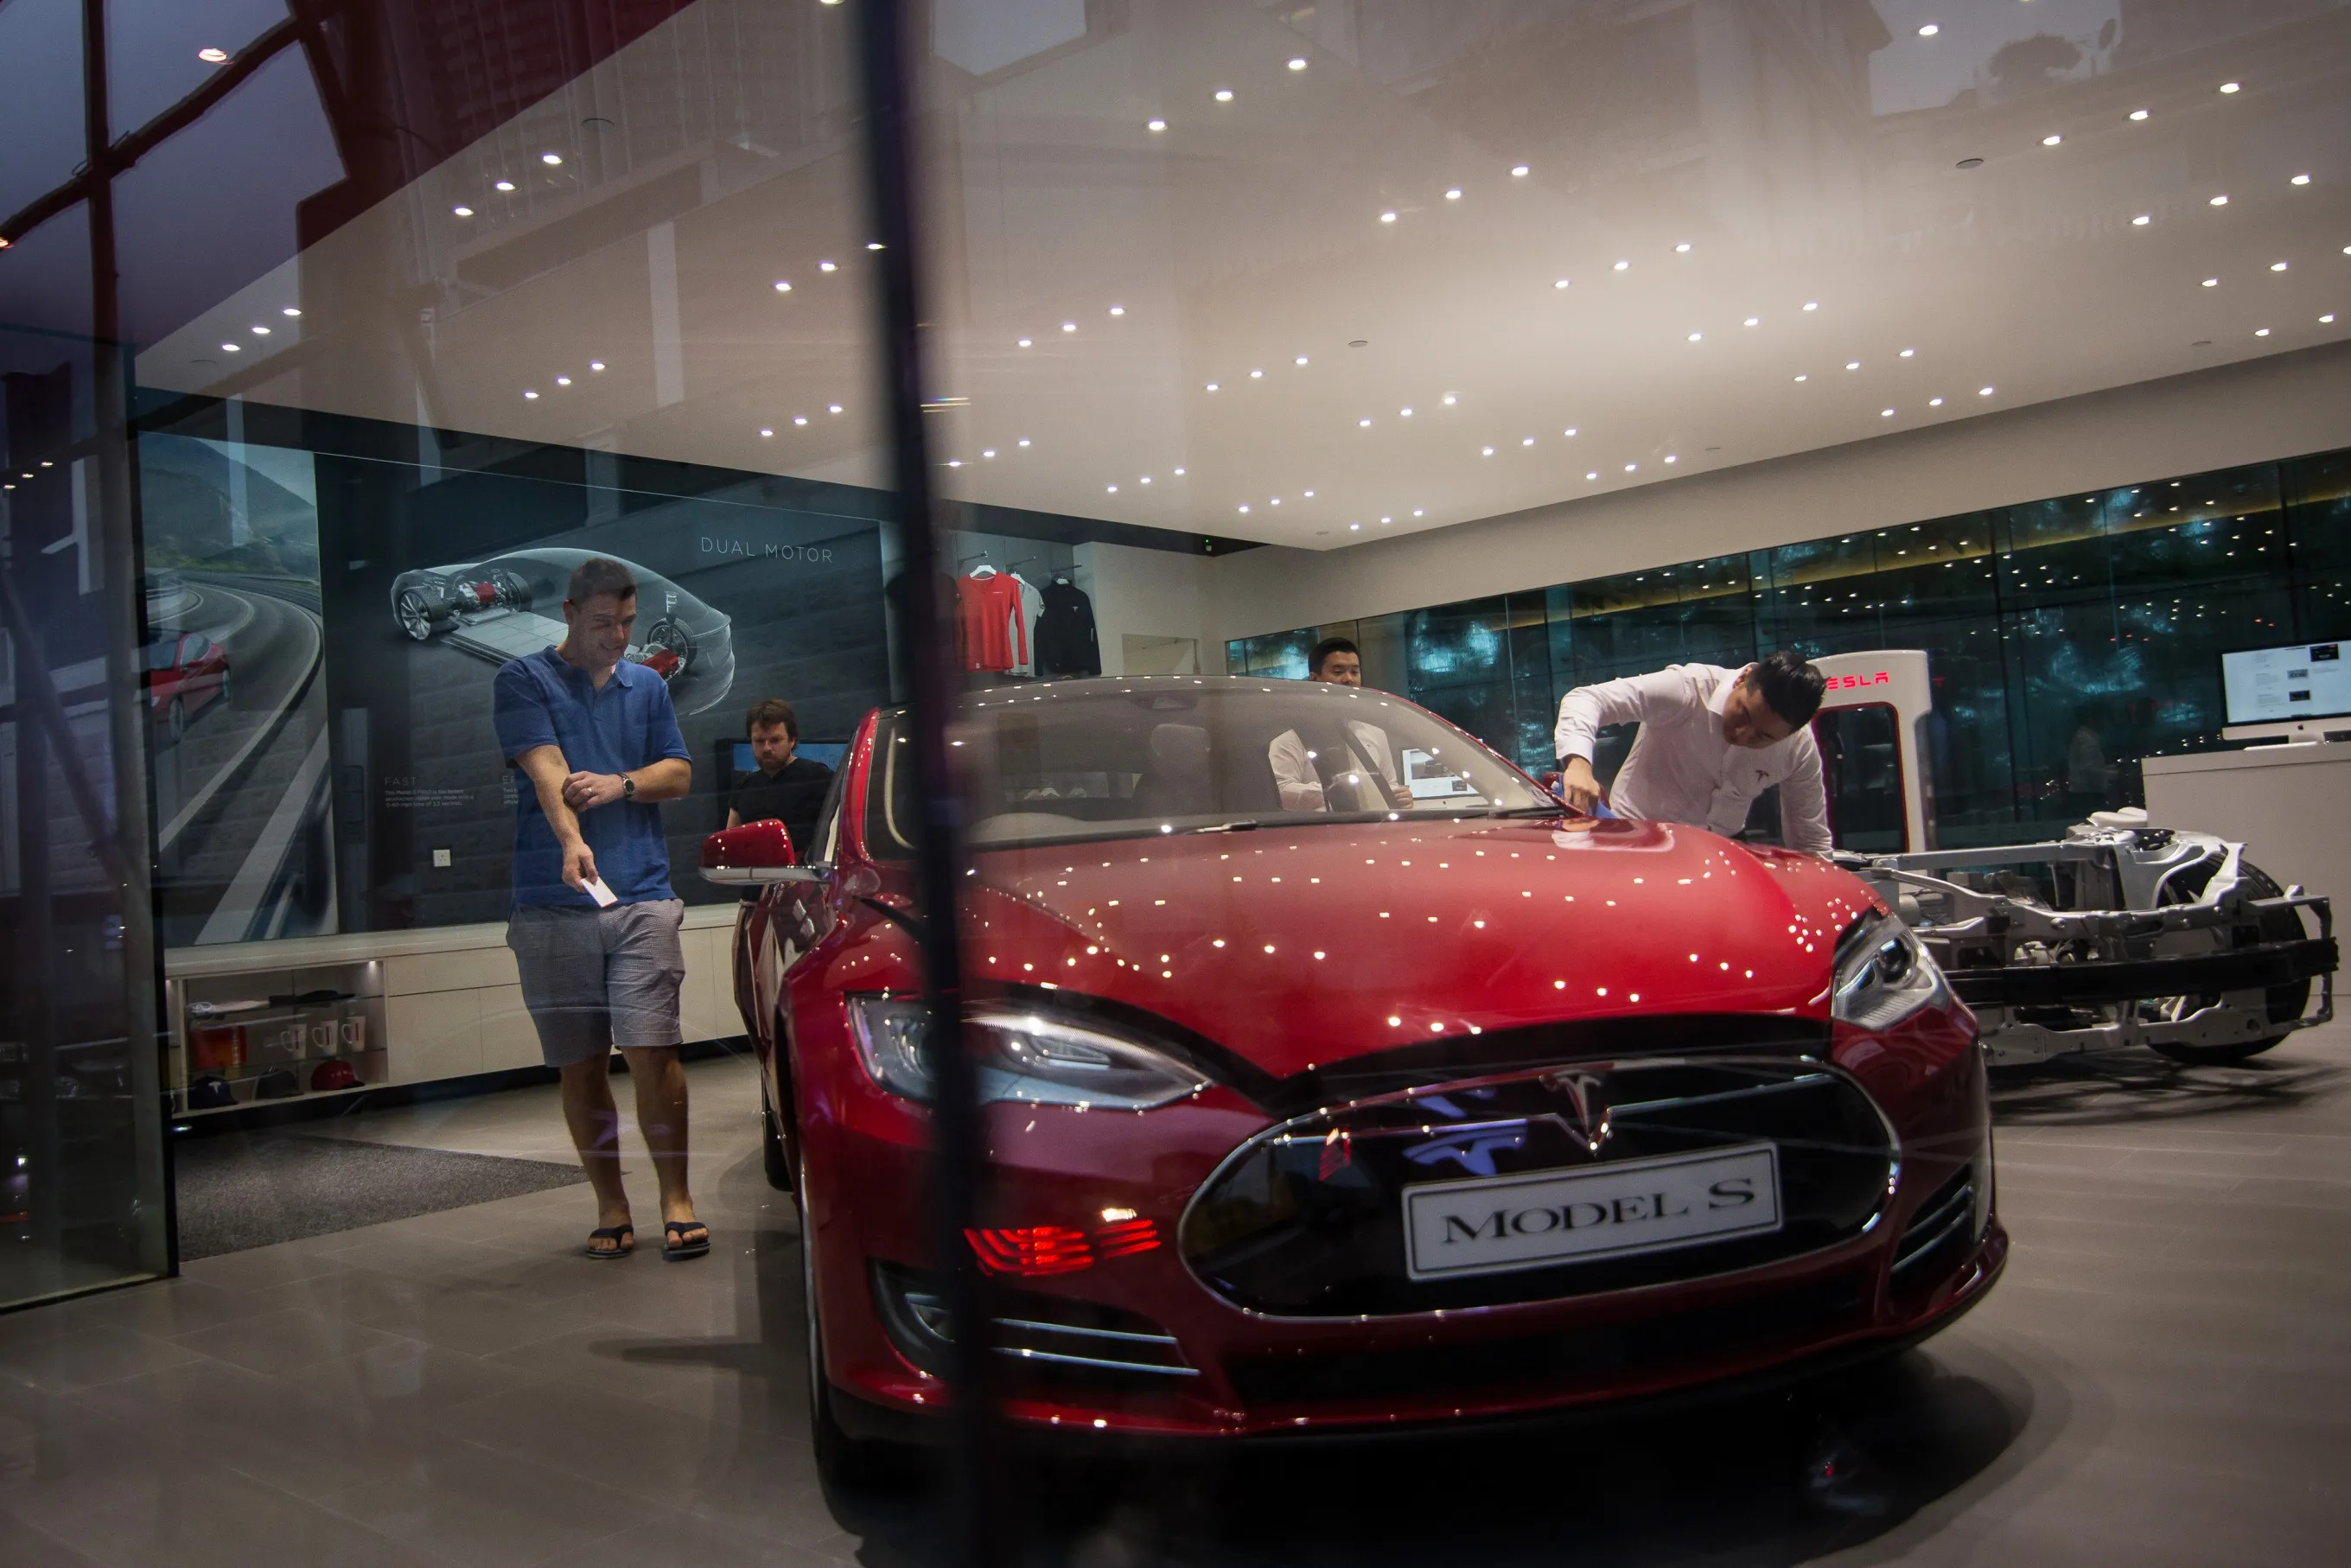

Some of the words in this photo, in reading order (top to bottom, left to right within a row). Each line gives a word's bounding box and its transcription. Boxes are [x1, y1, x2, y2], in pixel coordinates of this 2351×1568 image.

[701, 537, 755, 557] DUAL
[765, 544, 833, 564] MOTOR
[1826, 672, 1888, 689] ESLA
[385, 776, 417, 786] FAST
[1441, 1192, 1688, 1244] MODEL
[1707, 1177, 1755, 1209] S
